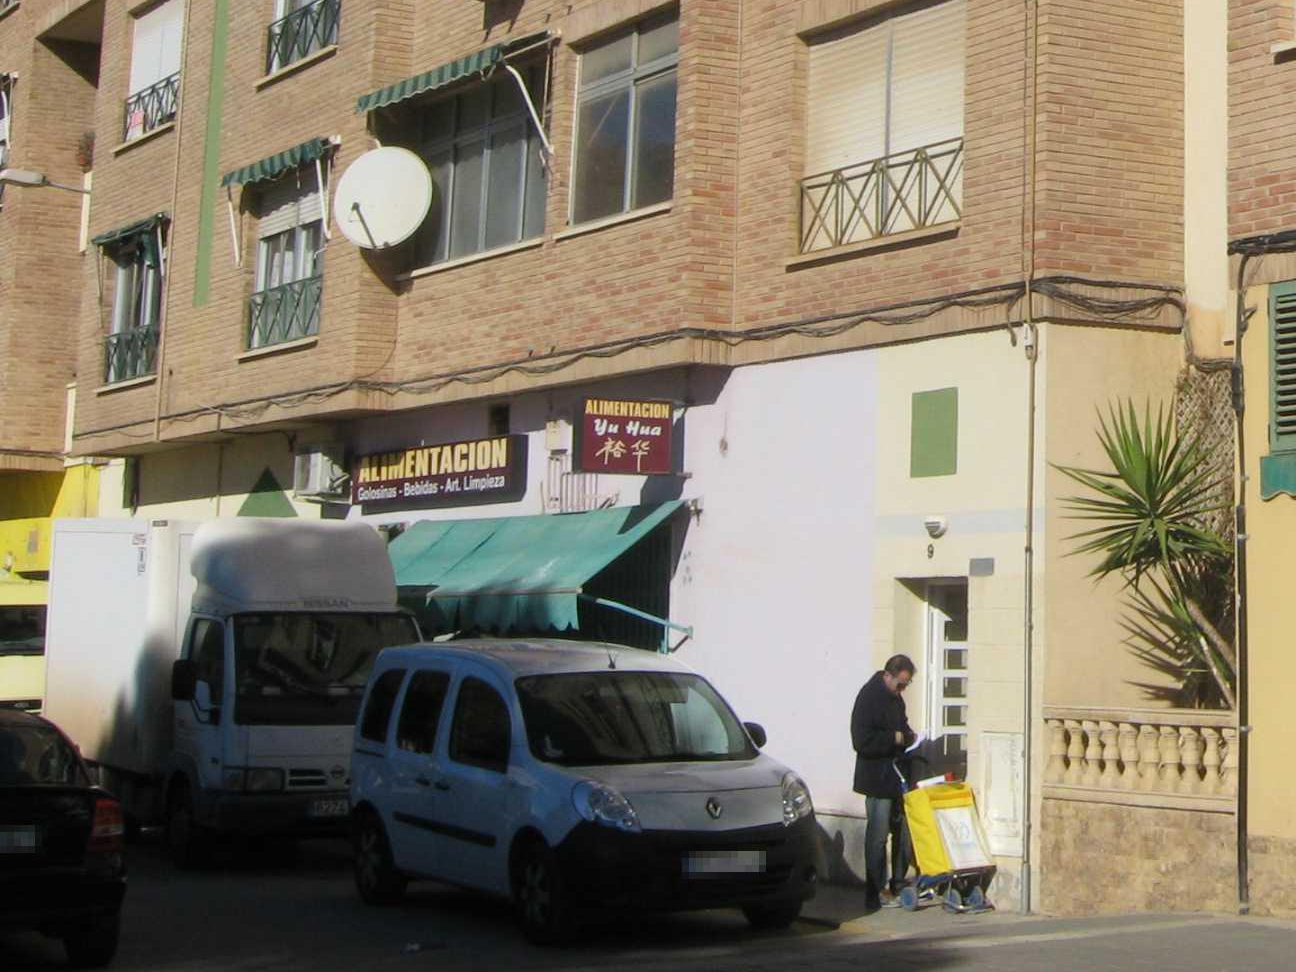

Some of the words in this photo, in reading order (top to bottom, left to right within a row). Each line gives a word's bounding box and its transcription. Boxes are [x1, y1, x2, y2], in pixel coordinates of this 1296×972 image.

[585, 399, 670, 419] ALIMENTACION
[593, 418, 619, 436] Yu
[625, 420, 662, 437] Hua
[357, 437, 508, 484] ALIMENTACION
[357, 484, 397, 501] Golosinas
[403, 480, 439, 497] Bebidas
[445, 477, 461, 493] Art.
[463, 474, 506, 492] Limpieza
[927, 543, 934, 559] 9
